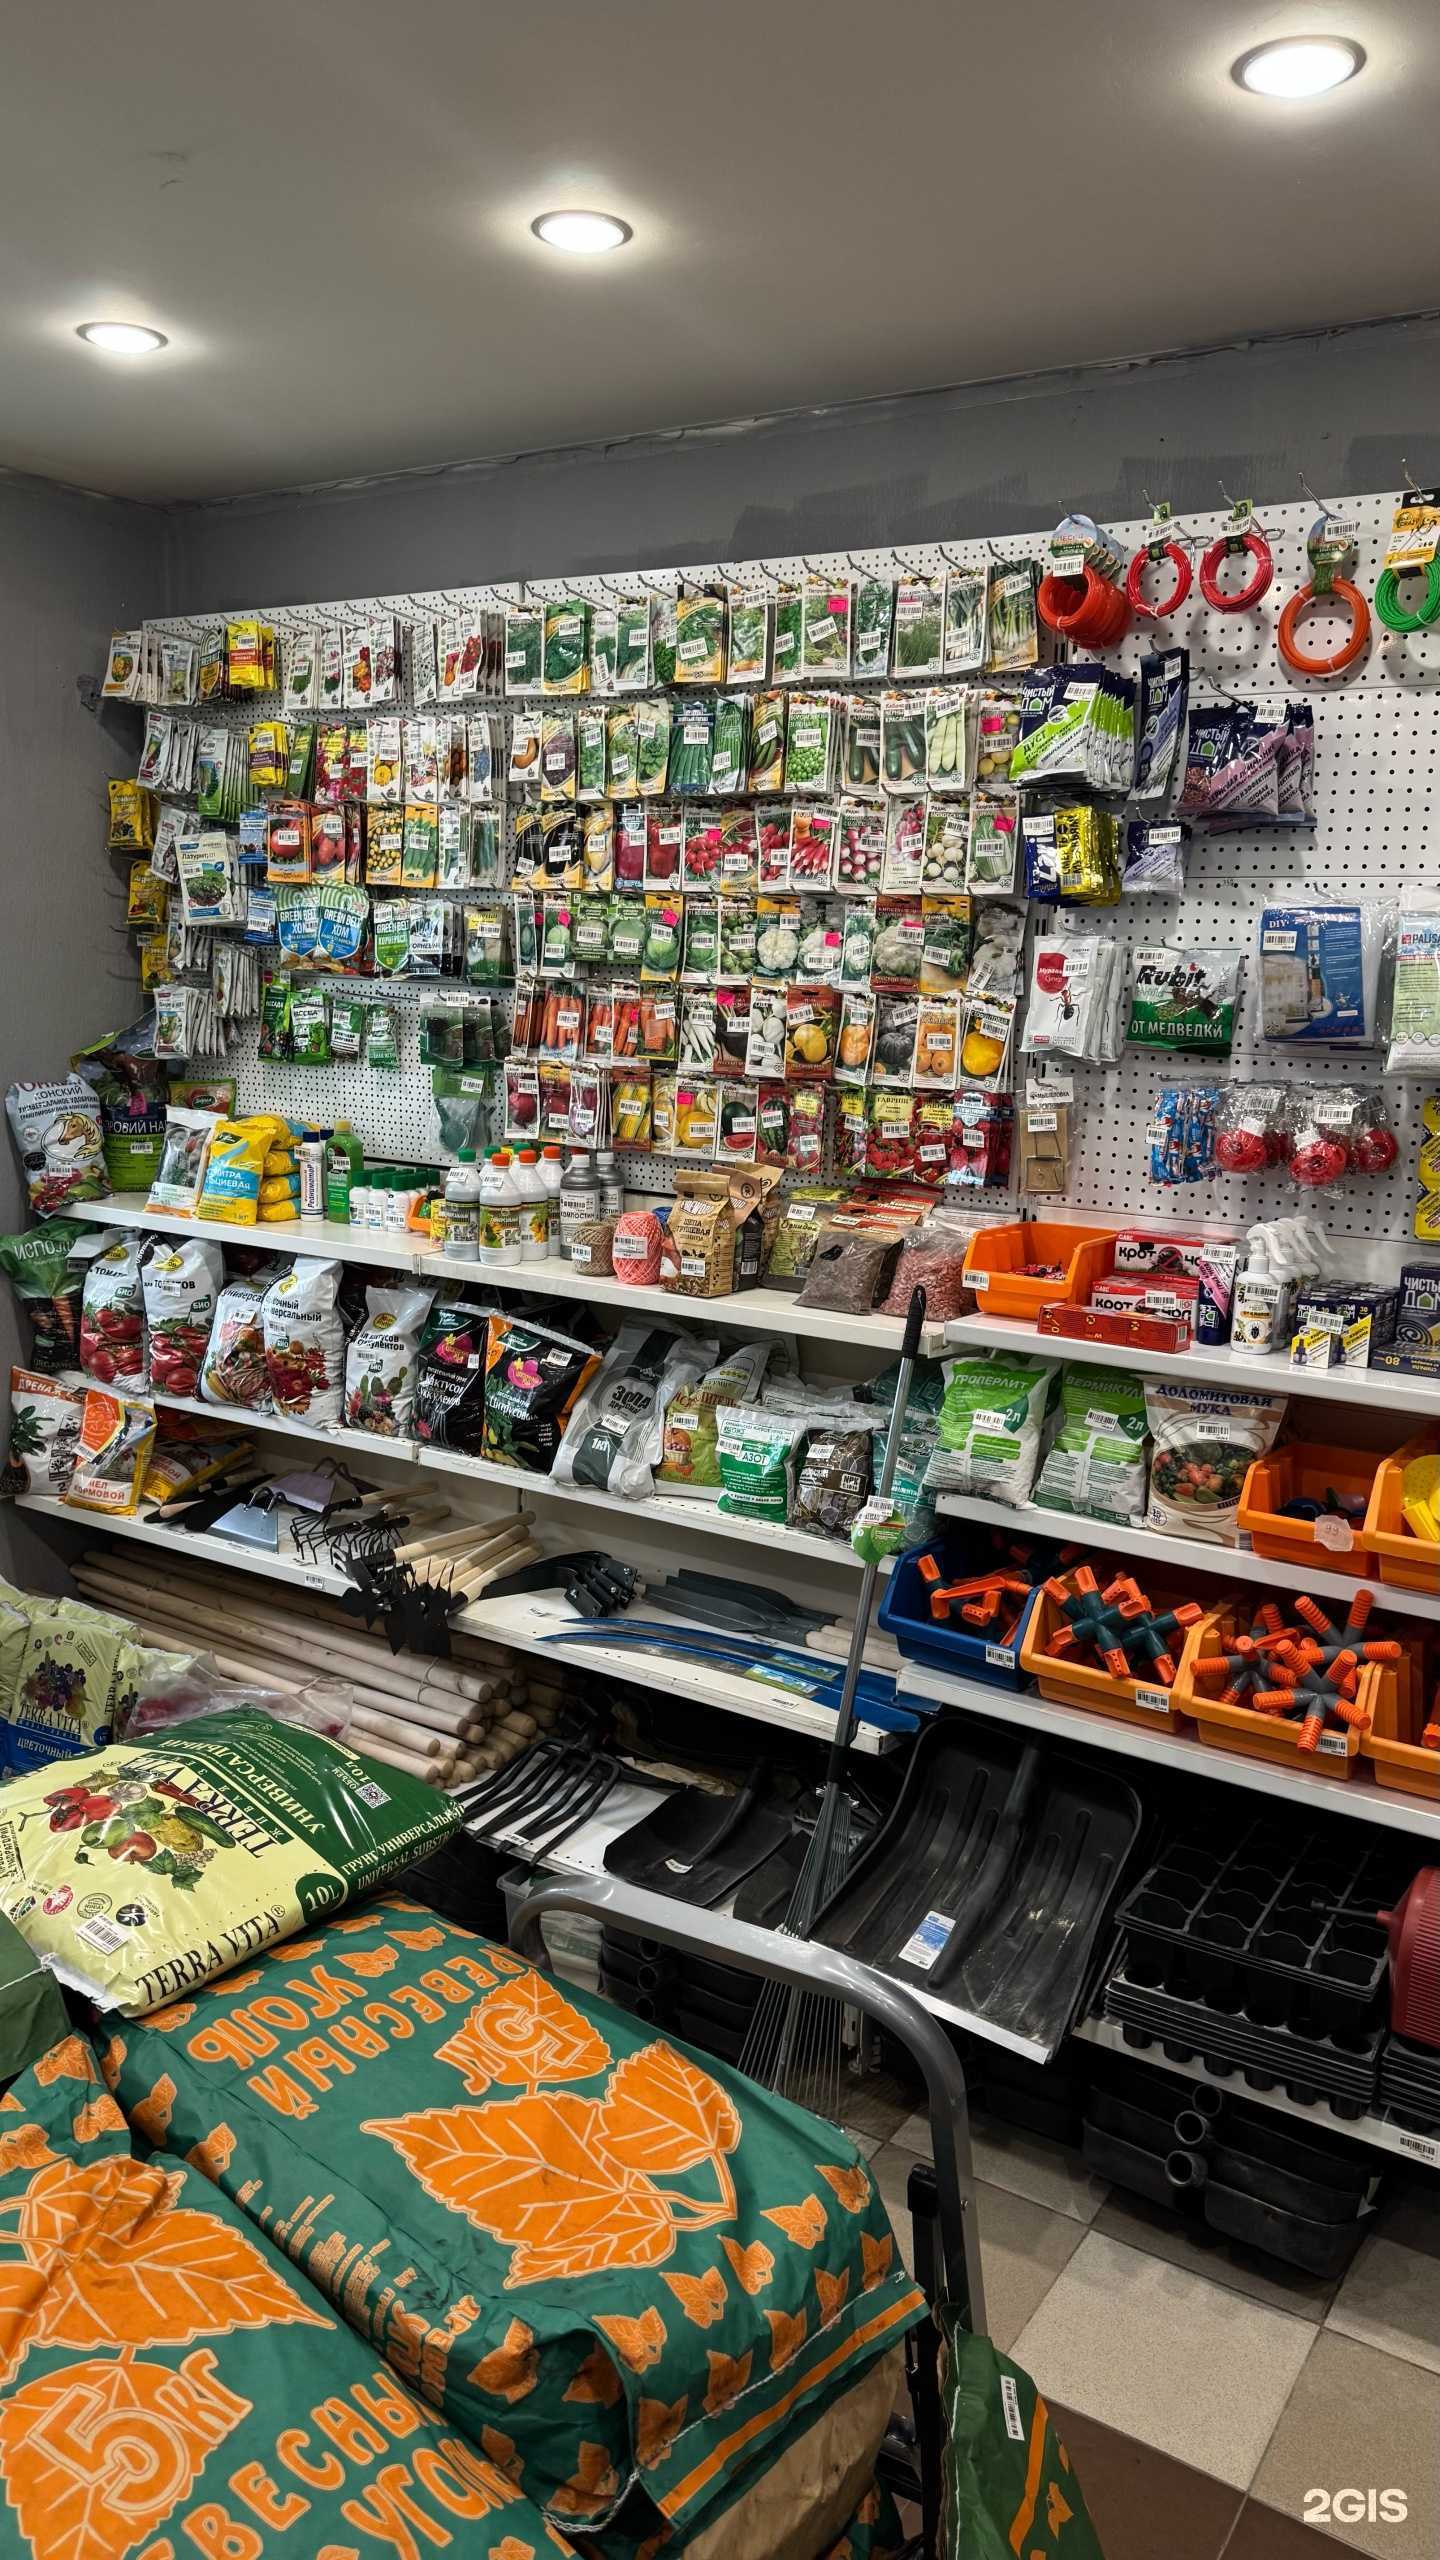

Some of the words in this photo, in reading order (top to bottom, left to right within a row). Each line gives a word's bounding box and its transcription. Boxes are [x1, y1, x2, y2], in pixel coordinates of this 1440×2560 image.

[1022, 685, 1055, 698] ЧИСТЫЙ
[1131, 1021, 1145, 1035] ОТ
[1149, 1022, 1223, 1039] МЕДВЕДКИ
[155, 1279, 196, 1289] ТОТОВ
[222, 1288, 263, 1302] универса
[263, 1307, 322, 1321] уверсальный
[1155, 1384, 1273, 1407] ДОЛОМИТОВАЯ
[1190, 1403, 1232, 1416] МУКА
[742, 1452, 767, 1465] АЗОТ
[341, 1850, 380, 1875] ГРУНТ
[357, 1854, 413, 1891] UNIVERSAL
[135, 1940, 223, 2007] TERRA
[228, 1911, 282, 1956] VITA
[187, 1964, 369, 2071] УГОЛЬ
[248, 1945, 526, 2120] РЕВЕСНЫЙ
